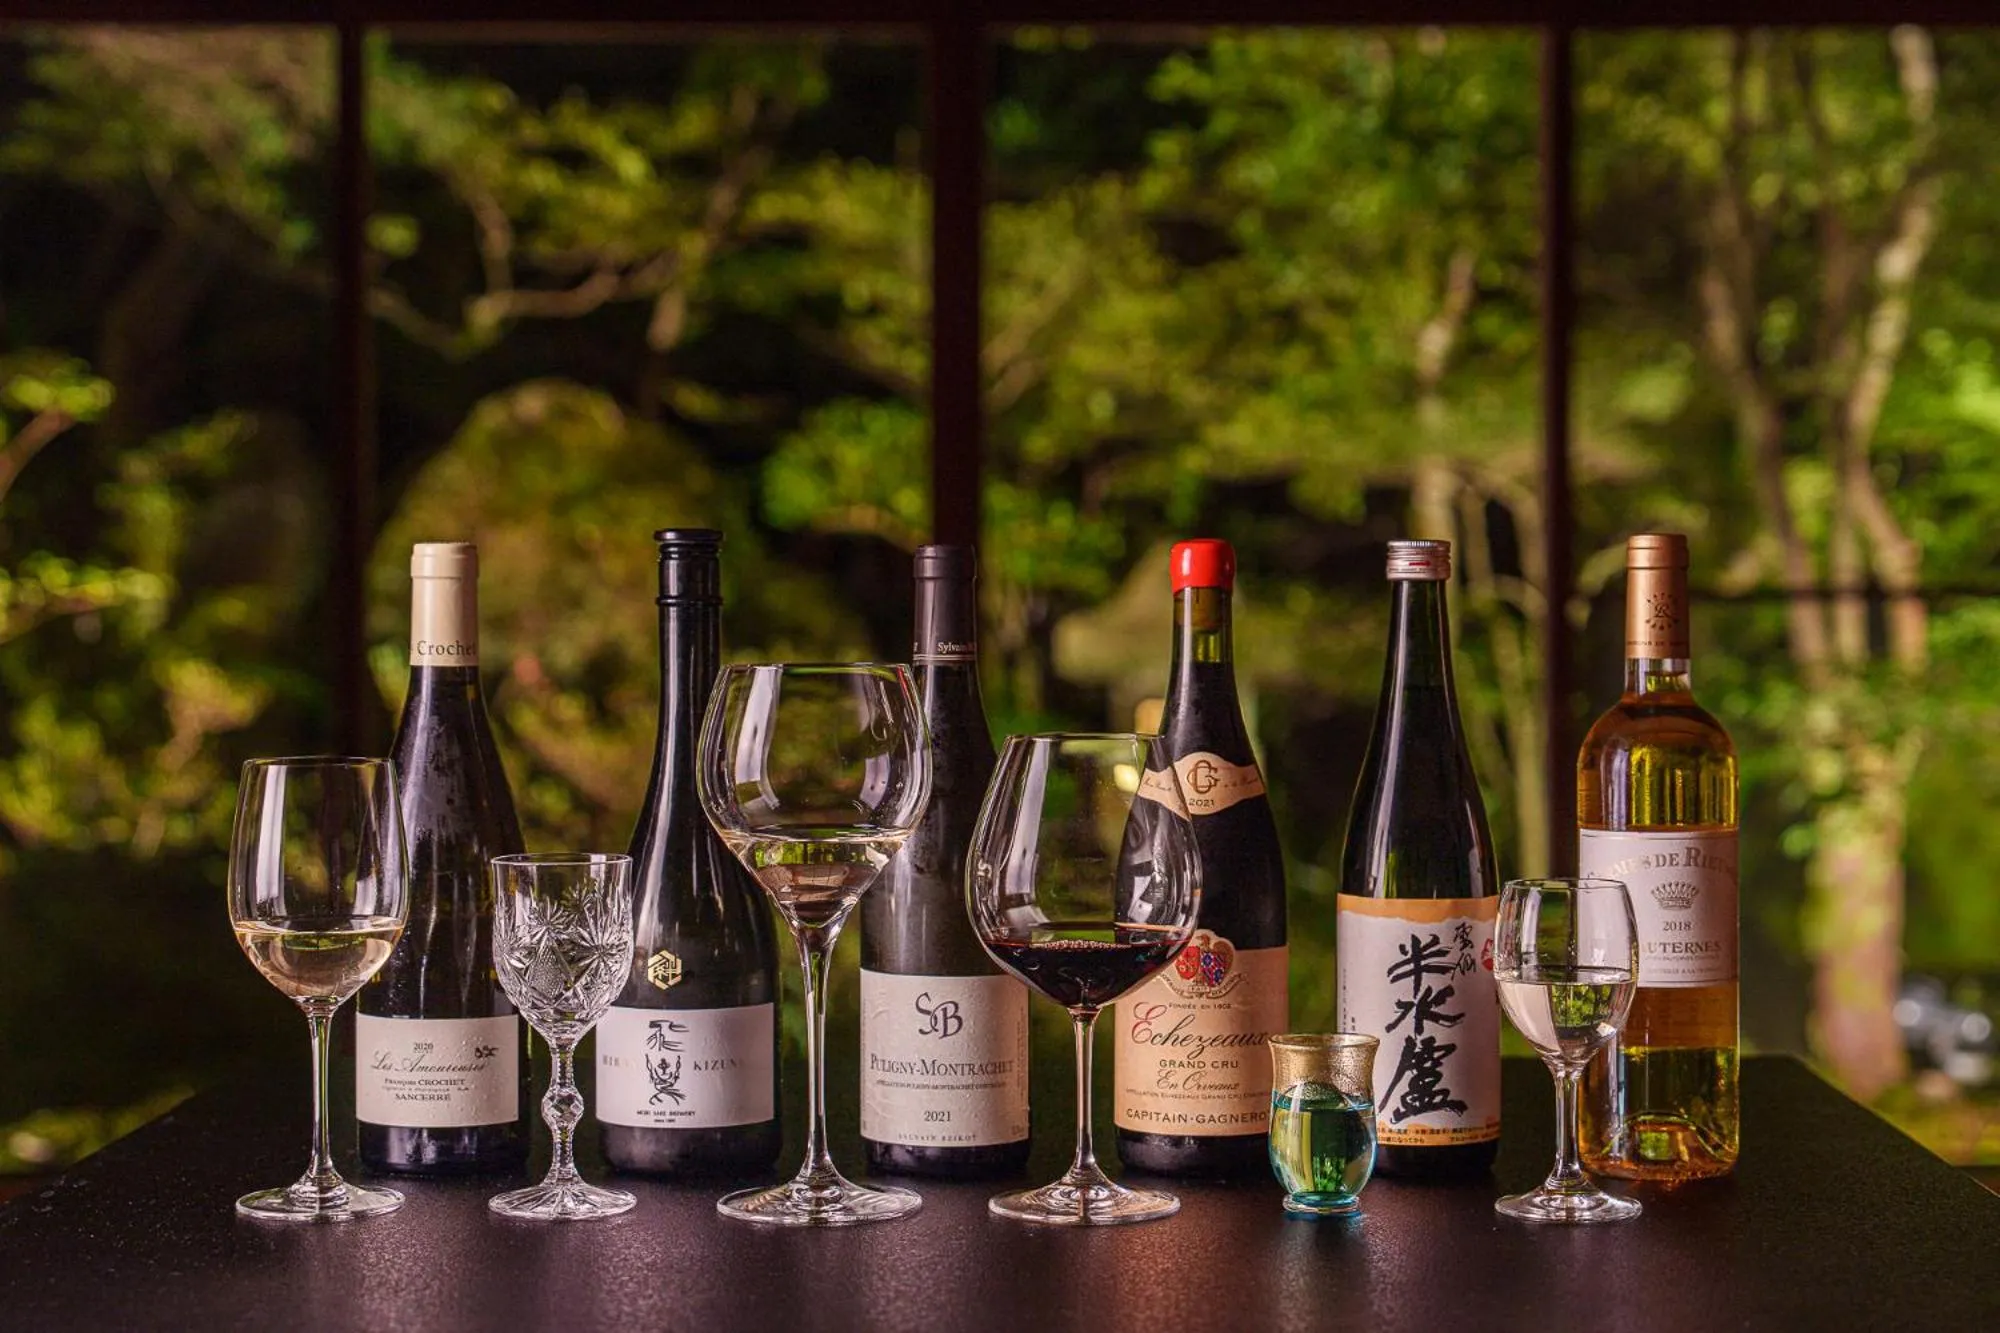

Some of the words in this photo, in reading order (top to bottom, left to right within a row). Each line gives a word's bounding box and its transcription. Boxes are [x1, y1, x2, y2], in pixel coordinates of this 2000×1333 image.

[1188, 798, 1216, 808] 2021
[1663, 920, 1693, 933] 2018
[1641, 940, 1722, 955] UTERNES
[1131, 1002, 1269, 1059] Echezeaux
[413, 1042, 434, 1050] 2020
[1159, 1060, 1206, 1070] GRAND
[1211, 1060, 1239, 1069] CRU
[395, 1093, 452, 1101] SANCERRE
[923, 1110, 952, 1123] 2021
